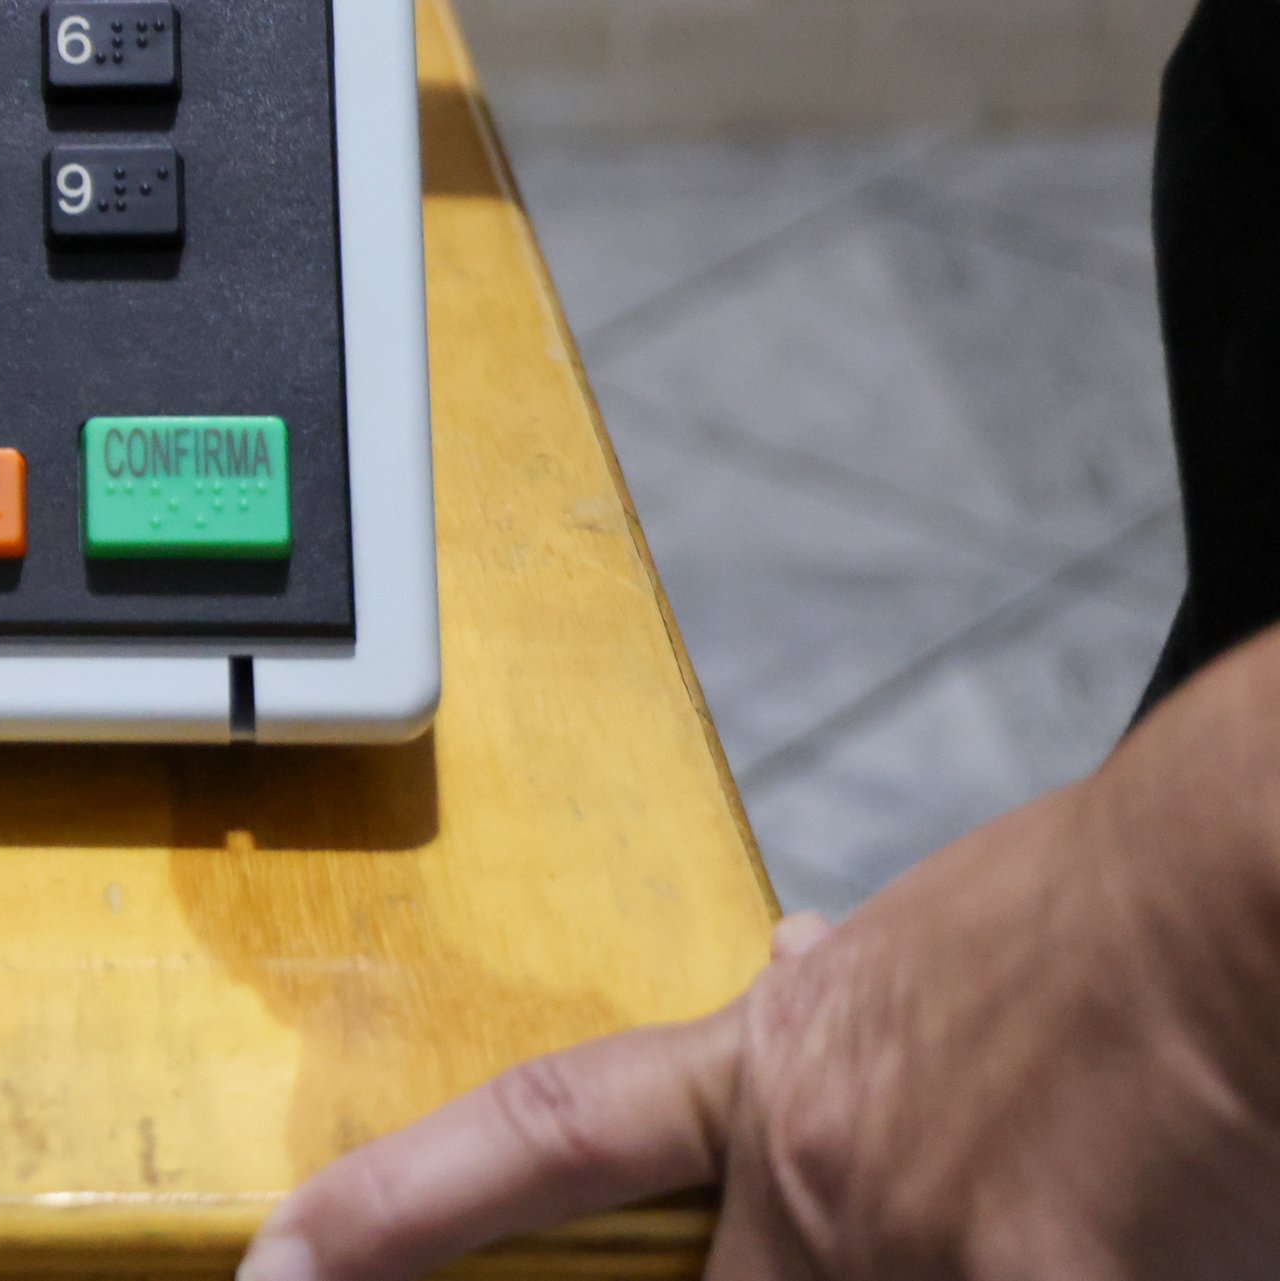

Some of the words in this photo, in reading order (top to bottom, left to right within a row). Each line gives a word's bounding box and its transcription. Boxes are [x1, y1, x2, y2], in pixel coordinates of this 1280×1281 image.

[56, 16, 93, 64] 6
[56, 163, 93, 214] 9
[103, 427, 273, 480] CONFIRMA
